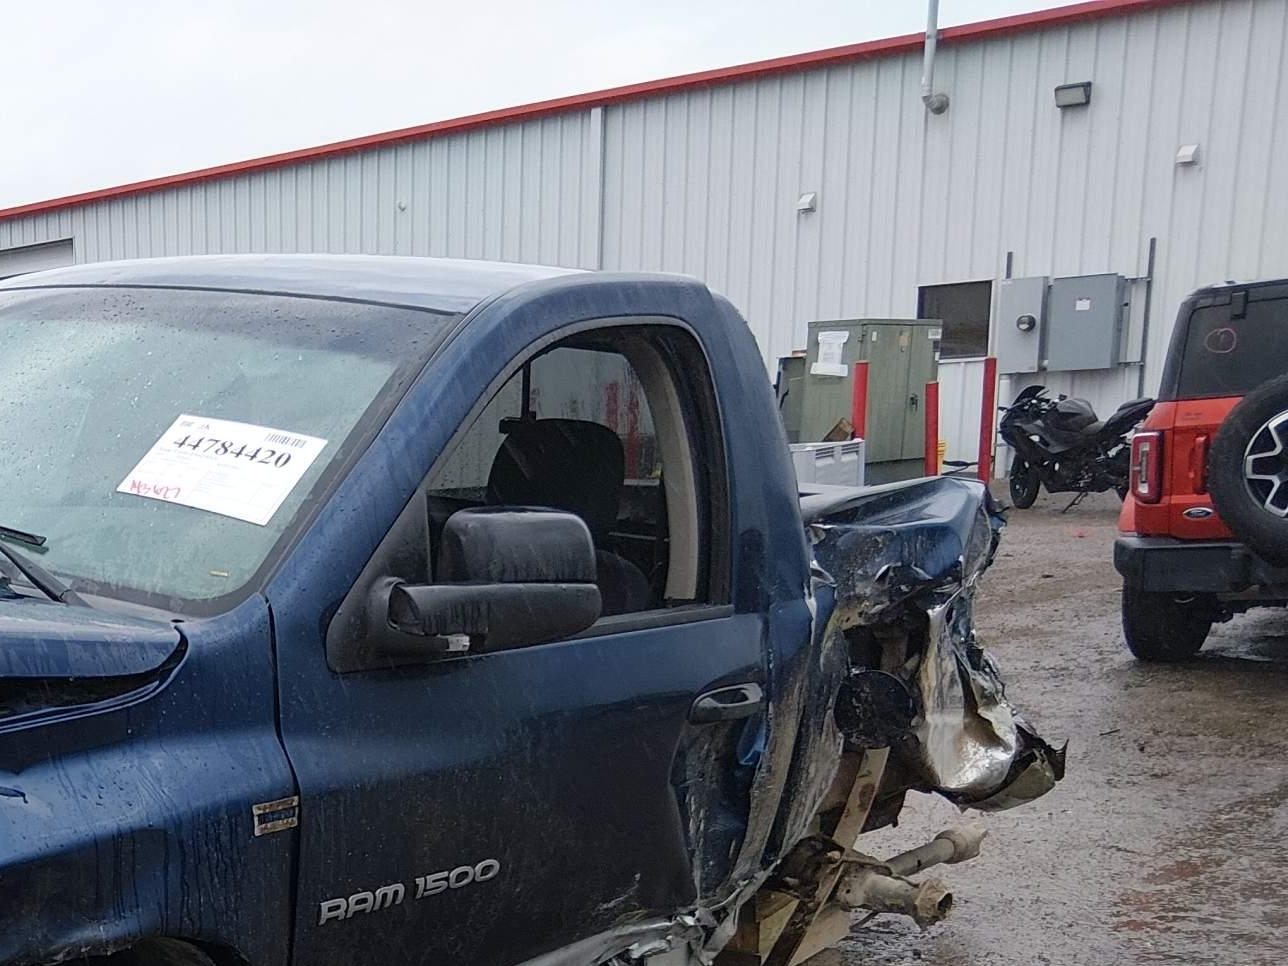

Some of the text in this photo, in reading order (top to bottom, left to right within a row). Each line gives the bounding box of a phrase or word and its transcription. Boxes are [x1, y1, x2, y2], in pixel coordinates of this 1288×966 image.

[173, 434, 292, 469] 44784420
[317, 858, 501, 926] RAM 1500
